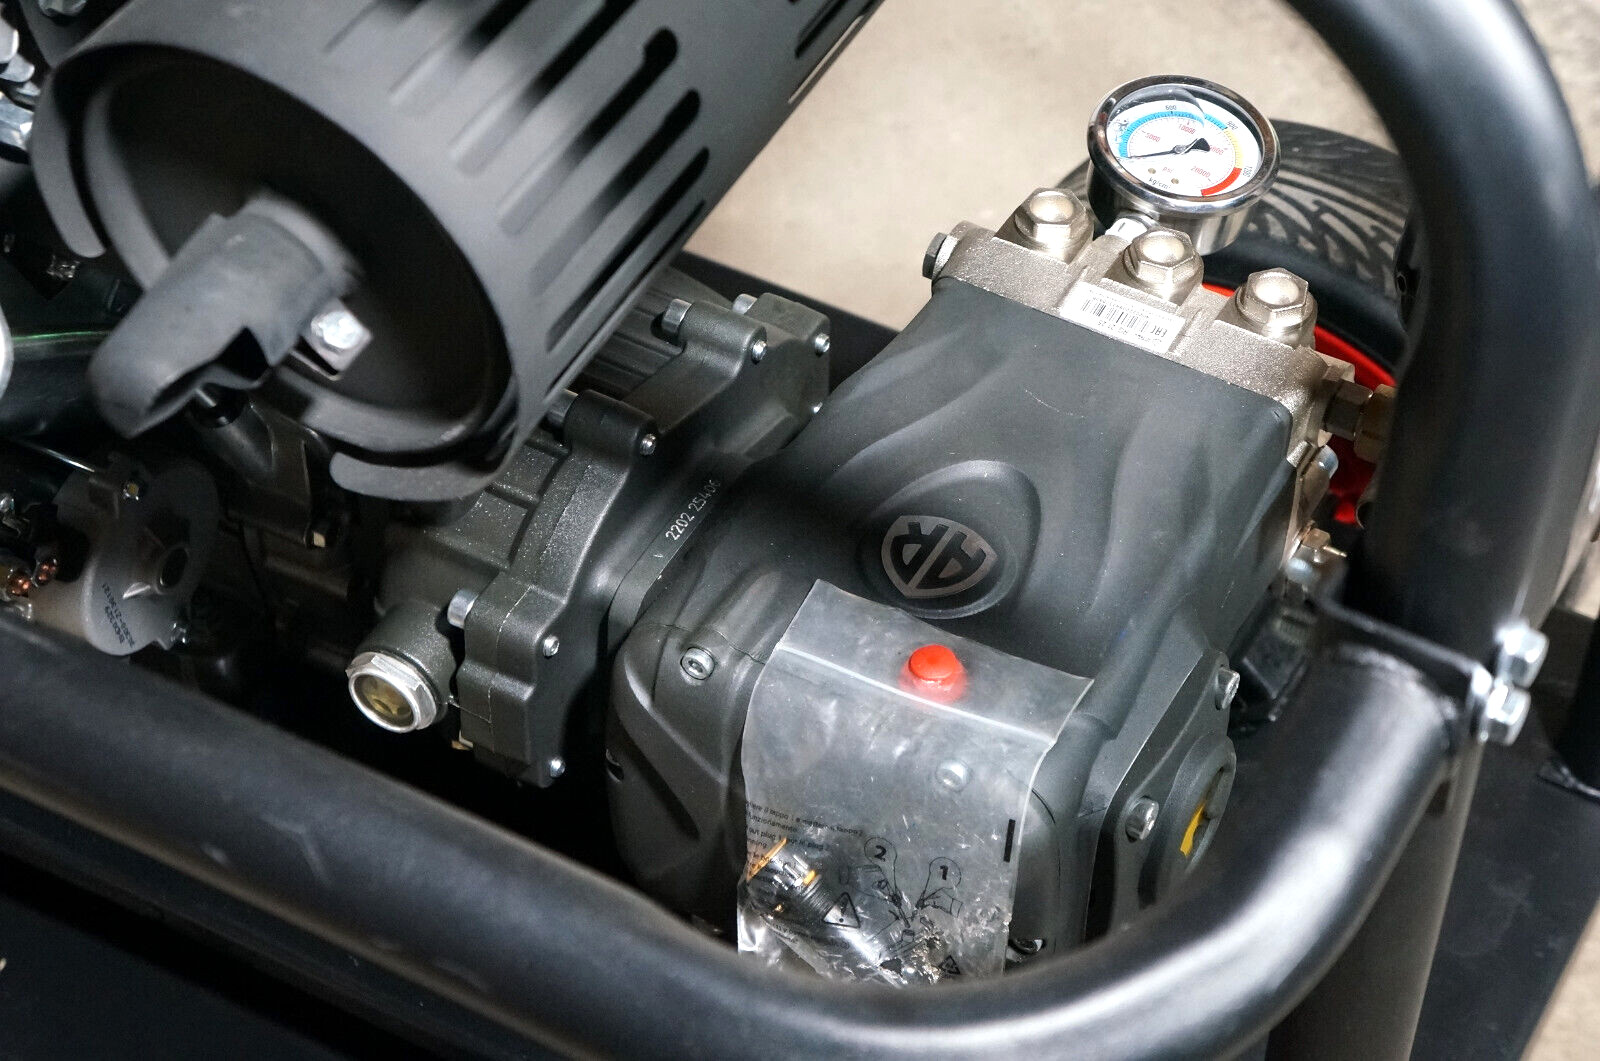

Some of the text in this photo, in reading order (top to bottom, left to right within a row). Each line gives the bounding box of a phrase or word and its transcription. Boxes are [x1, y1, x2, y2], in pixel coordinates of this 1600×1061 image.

[665, 512, 695, 541] 2202
[874, 844, 888, 861] 2
[940, 865, 949, 881] 1
